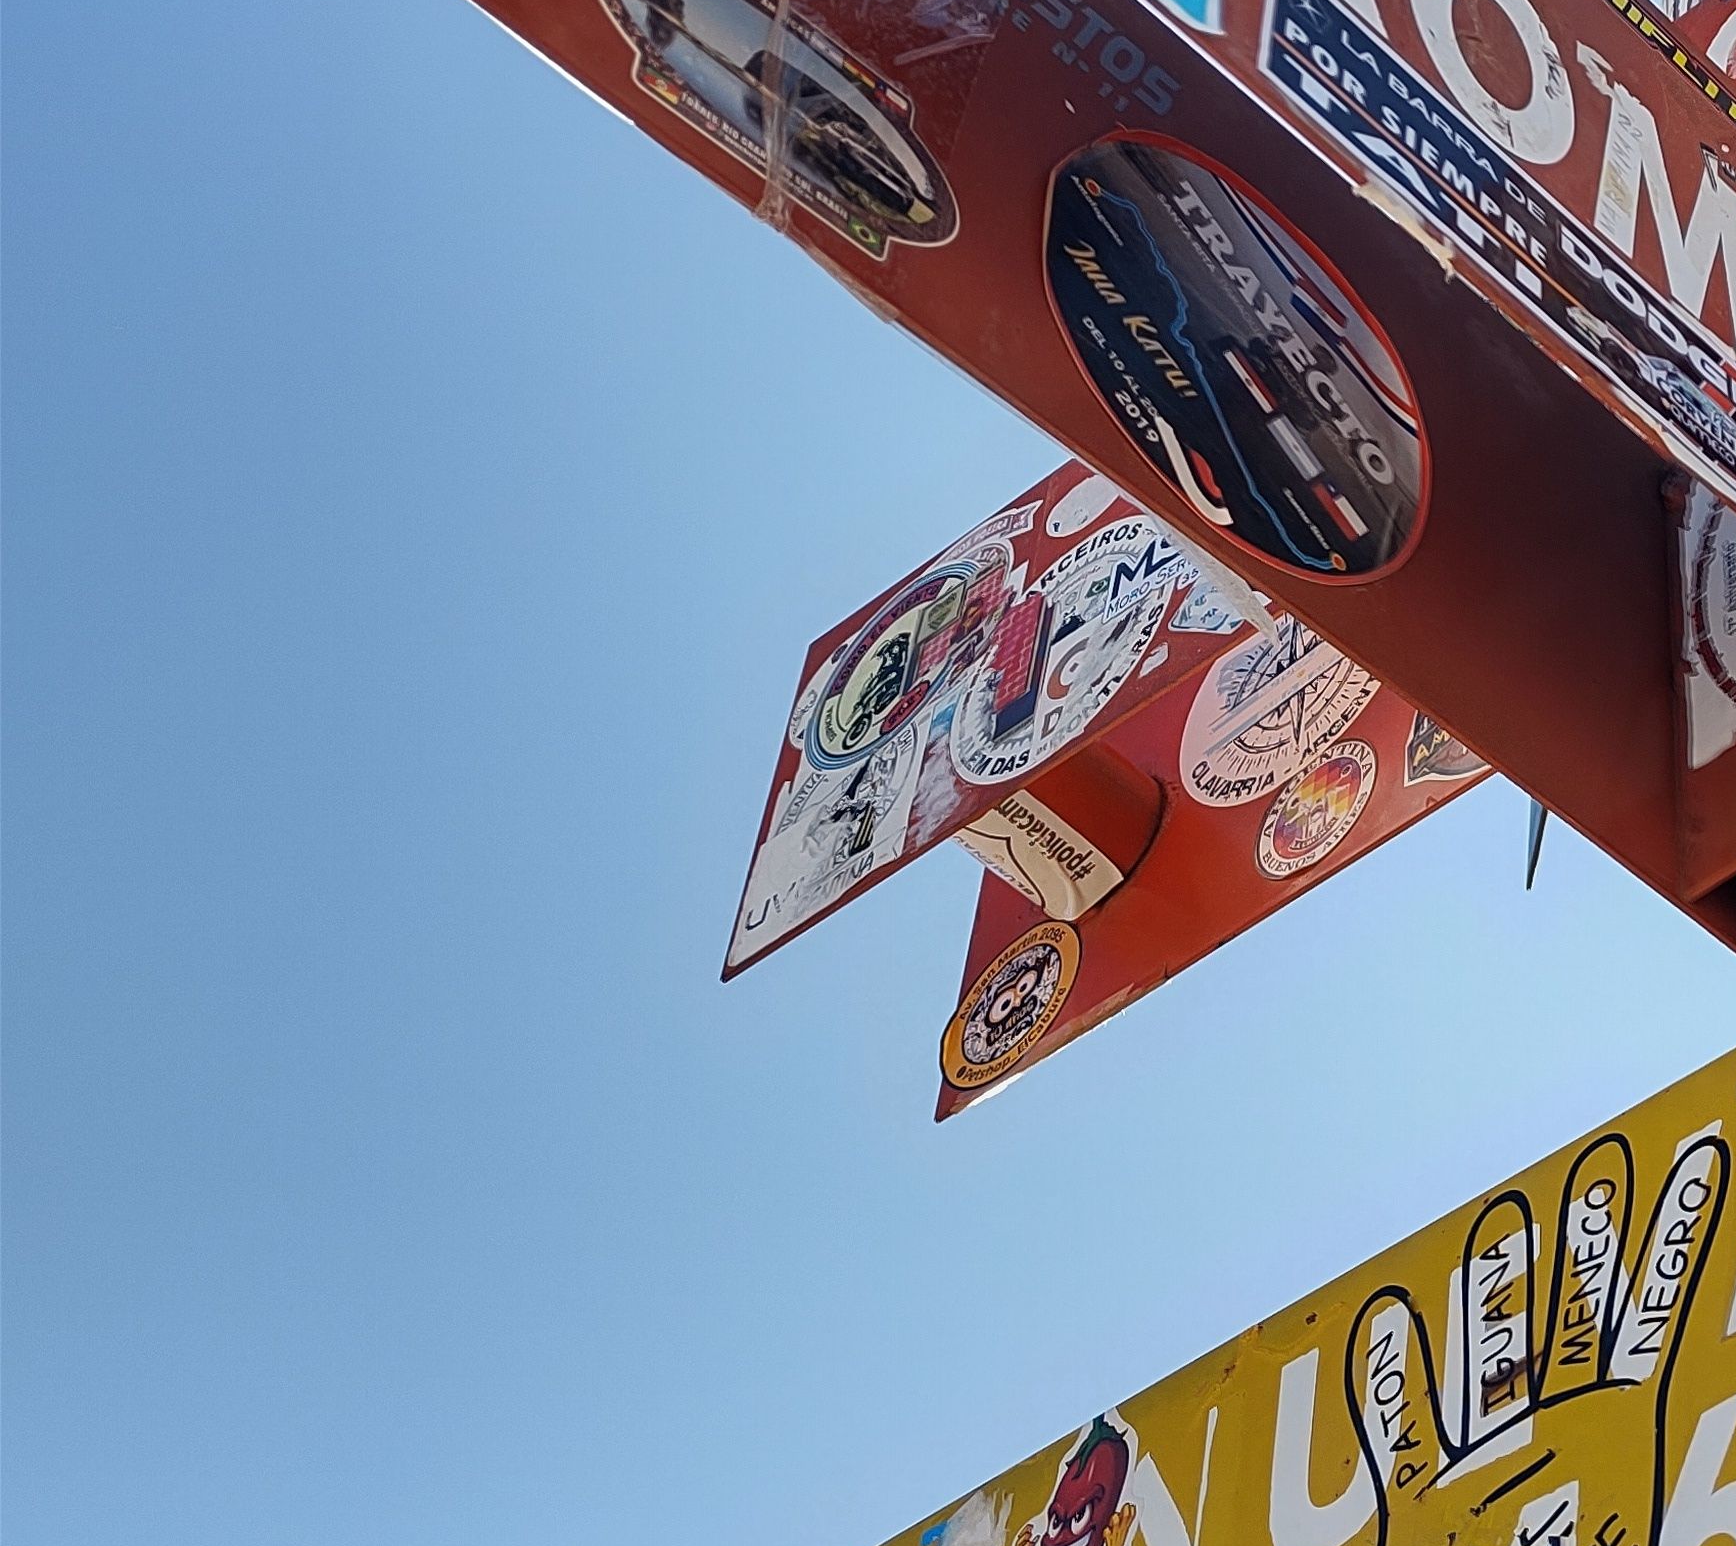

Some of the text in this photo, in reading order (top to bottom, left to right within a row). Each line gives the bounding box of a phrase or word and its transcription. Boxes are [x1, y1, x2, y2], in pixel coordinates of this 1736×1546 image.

[1282, 17, 1367, 112] POR
[1380, 102, 1551, 272] SIEMPRE
[1340, 27, 1549, 226] LA BARRA DE
[1080, 315, 1109, 354] DEL
[1171, 179, 1396, 486] TRAYECTO
[1113, 388, 1160, 445] 2019
[1107, 586, 1154, 621] MORO
[1189, 759, 1277, 801] OLAVARRIA
[1261, 845, 1317, 876] BUENOS
[1628, 1176, 1712, 1356] NEGRO
